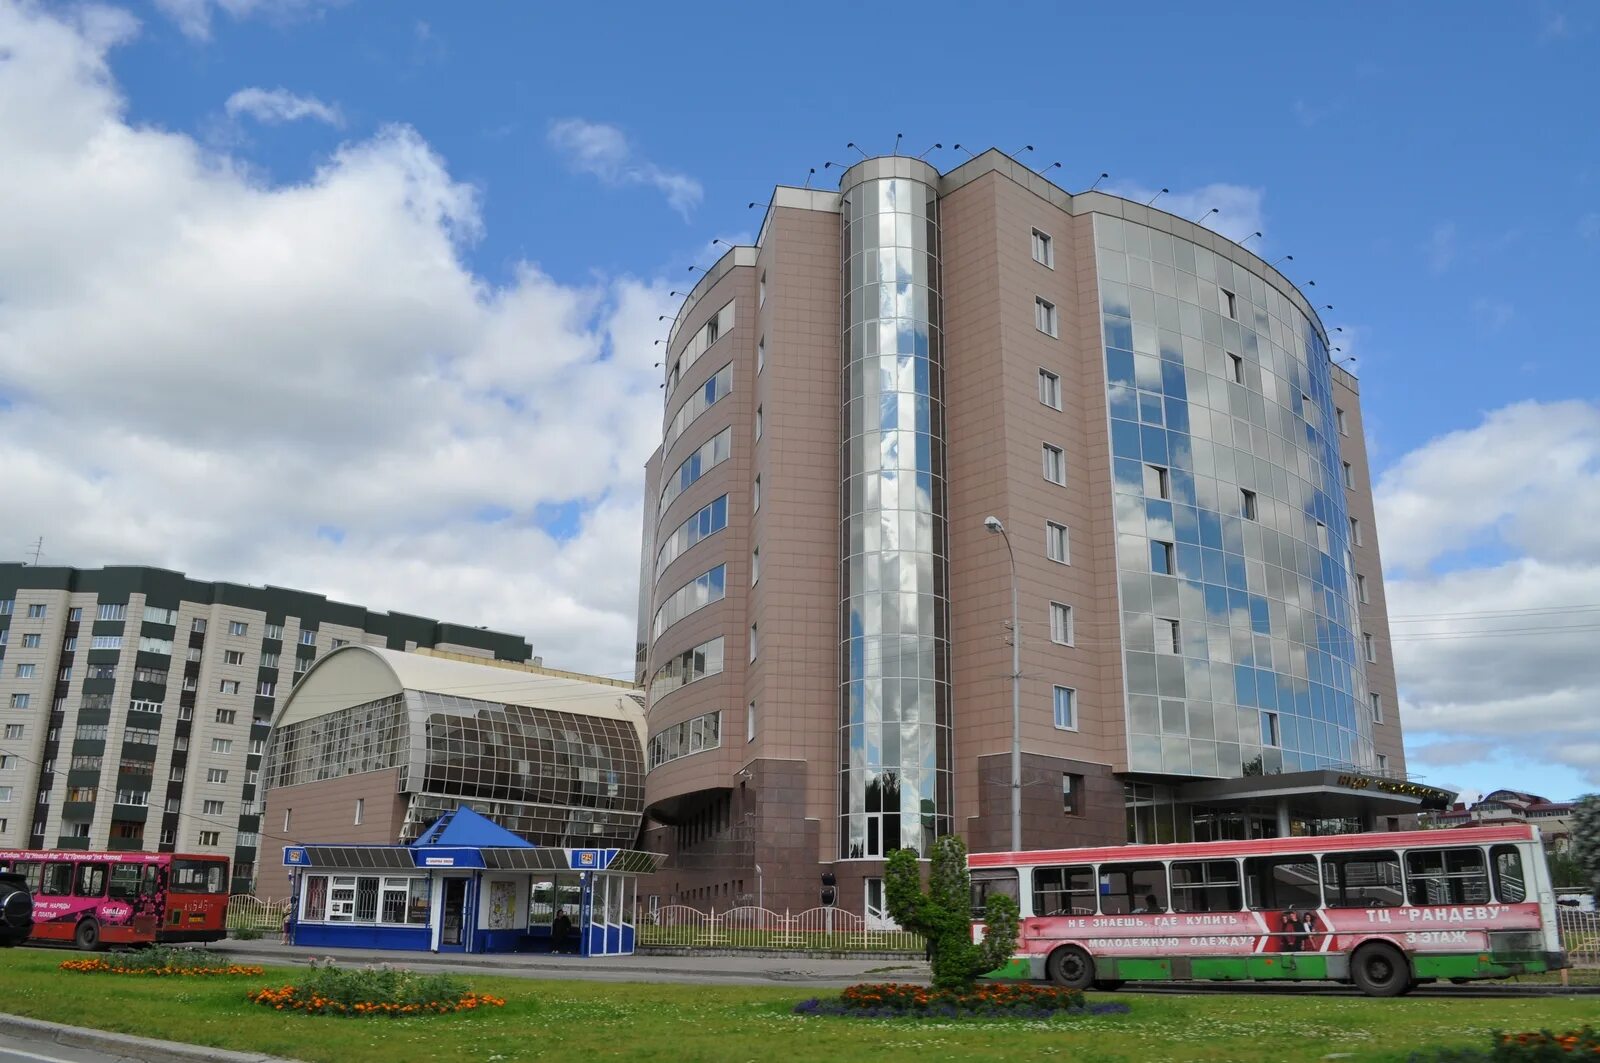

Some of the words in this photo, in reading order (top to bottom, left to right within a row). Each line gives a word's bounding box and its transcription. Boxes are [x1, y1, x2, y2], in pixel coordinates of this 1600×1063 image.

[1068, 919, 1086, 929] НЕ
[1154, 916, 1178, 927] ГДЕ
[1186, 916, 1238, 926] КУПИТЬ
[1366, 910, 1392, 923] ТЦ
[1088, 937, 1180, 948] МОЛОДЕЖНУЮ
[1190, 936, 1256, 947] ОДЕЖДУ?
[1406, 932, 1417, 944] 3
[1420, 931, 1469, 944] ЭТАЖ
